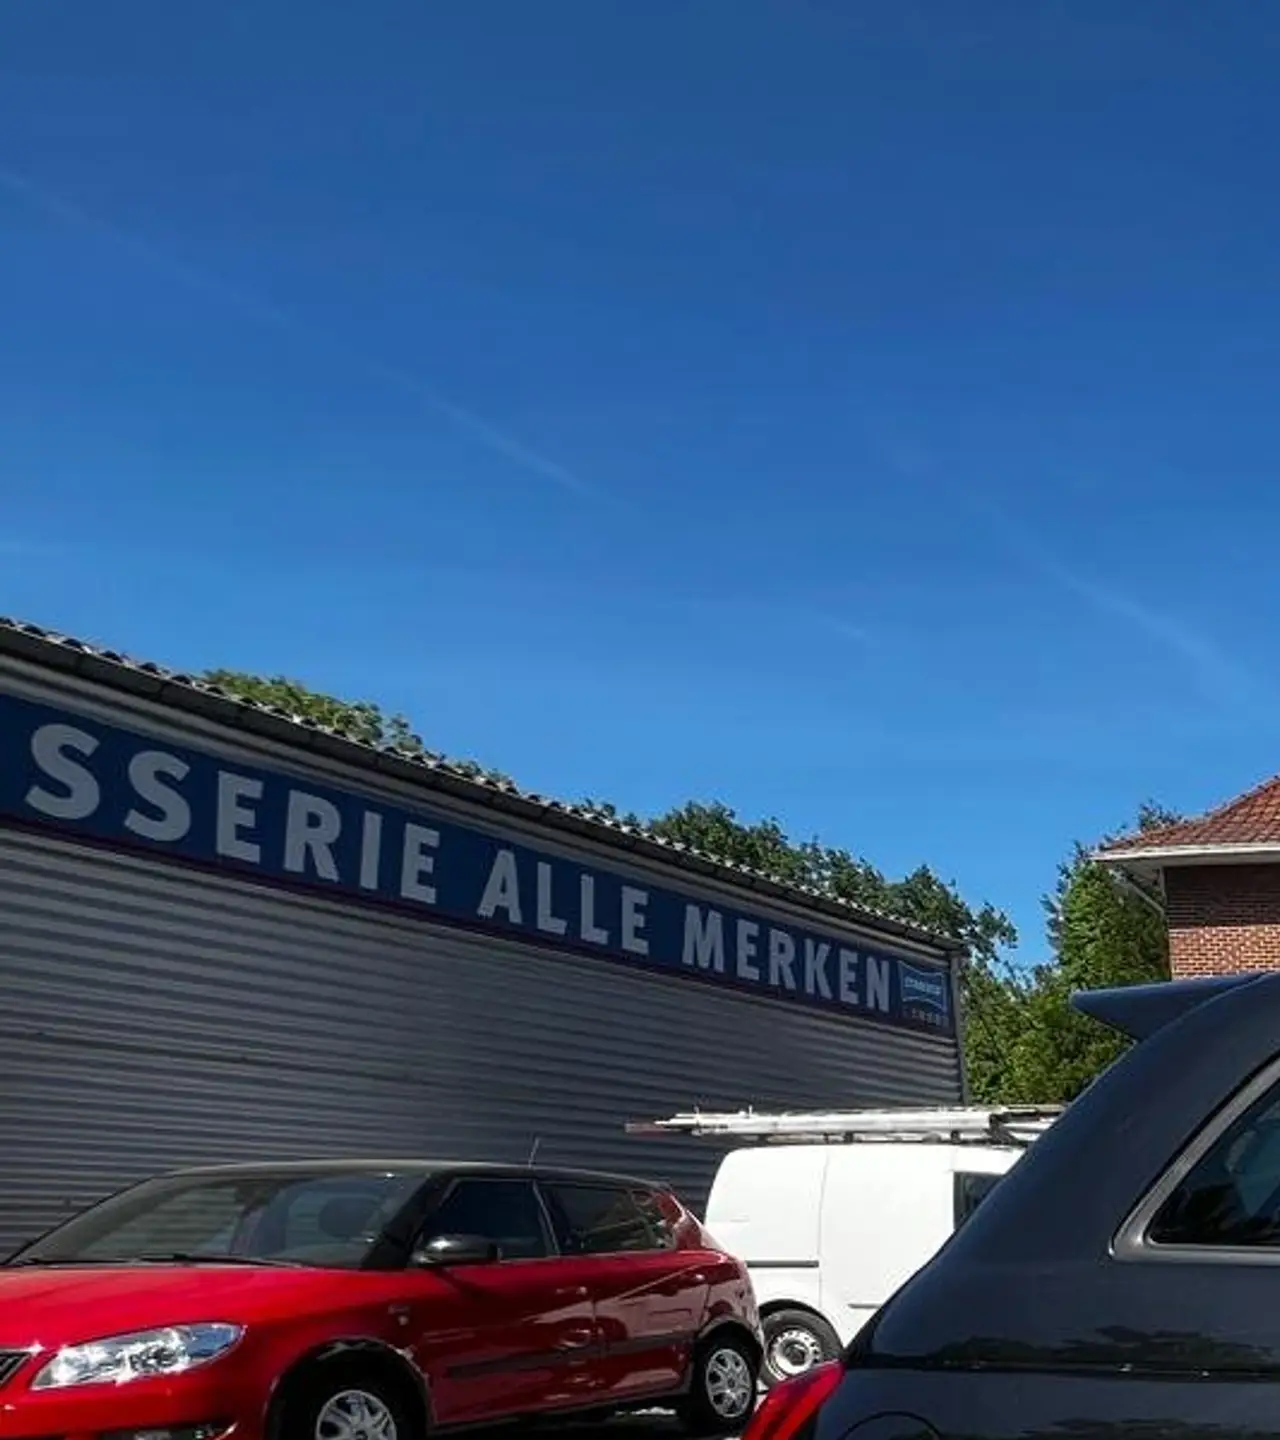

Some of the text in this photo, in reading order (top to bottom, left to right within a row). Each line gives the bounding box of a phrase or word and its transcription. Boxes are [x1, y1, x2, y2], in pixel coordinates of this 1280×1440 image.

[25, 723, 891, 1012] SSERIE ALLE MERKEN
